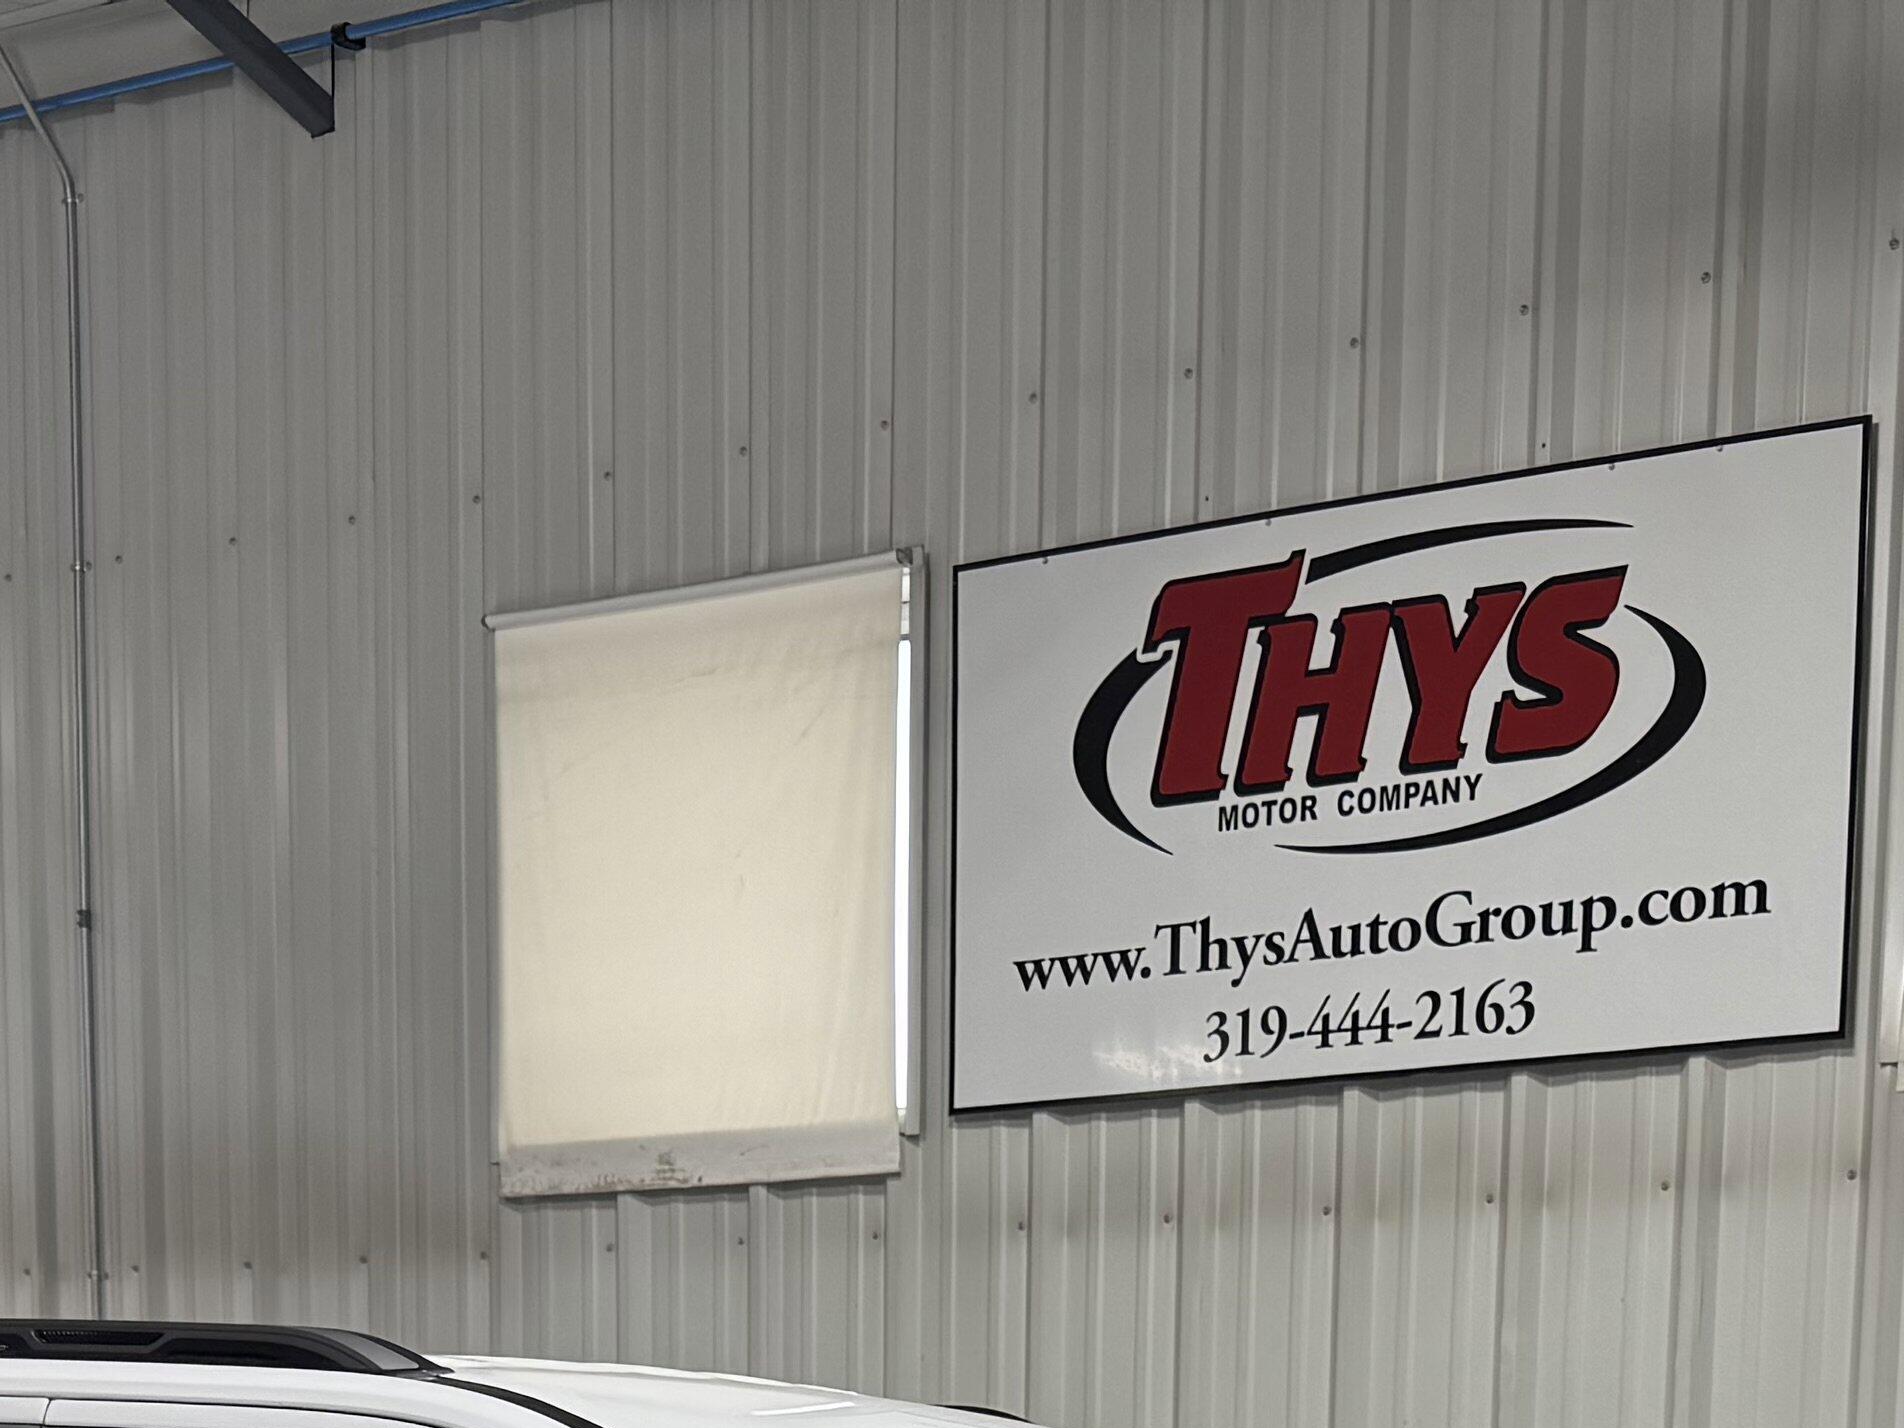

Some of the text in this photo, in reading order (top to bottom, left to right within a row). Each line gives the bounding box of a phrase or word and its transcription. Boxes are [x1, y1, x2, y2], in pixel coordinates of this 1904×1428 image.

[1216, 773, 1484, 833] MOTOR COMPANY
[1012, 876, 1772, 993] www.ThysAutoGroup.com
[1202, 979, 1536, 1063] 319-444-2163
